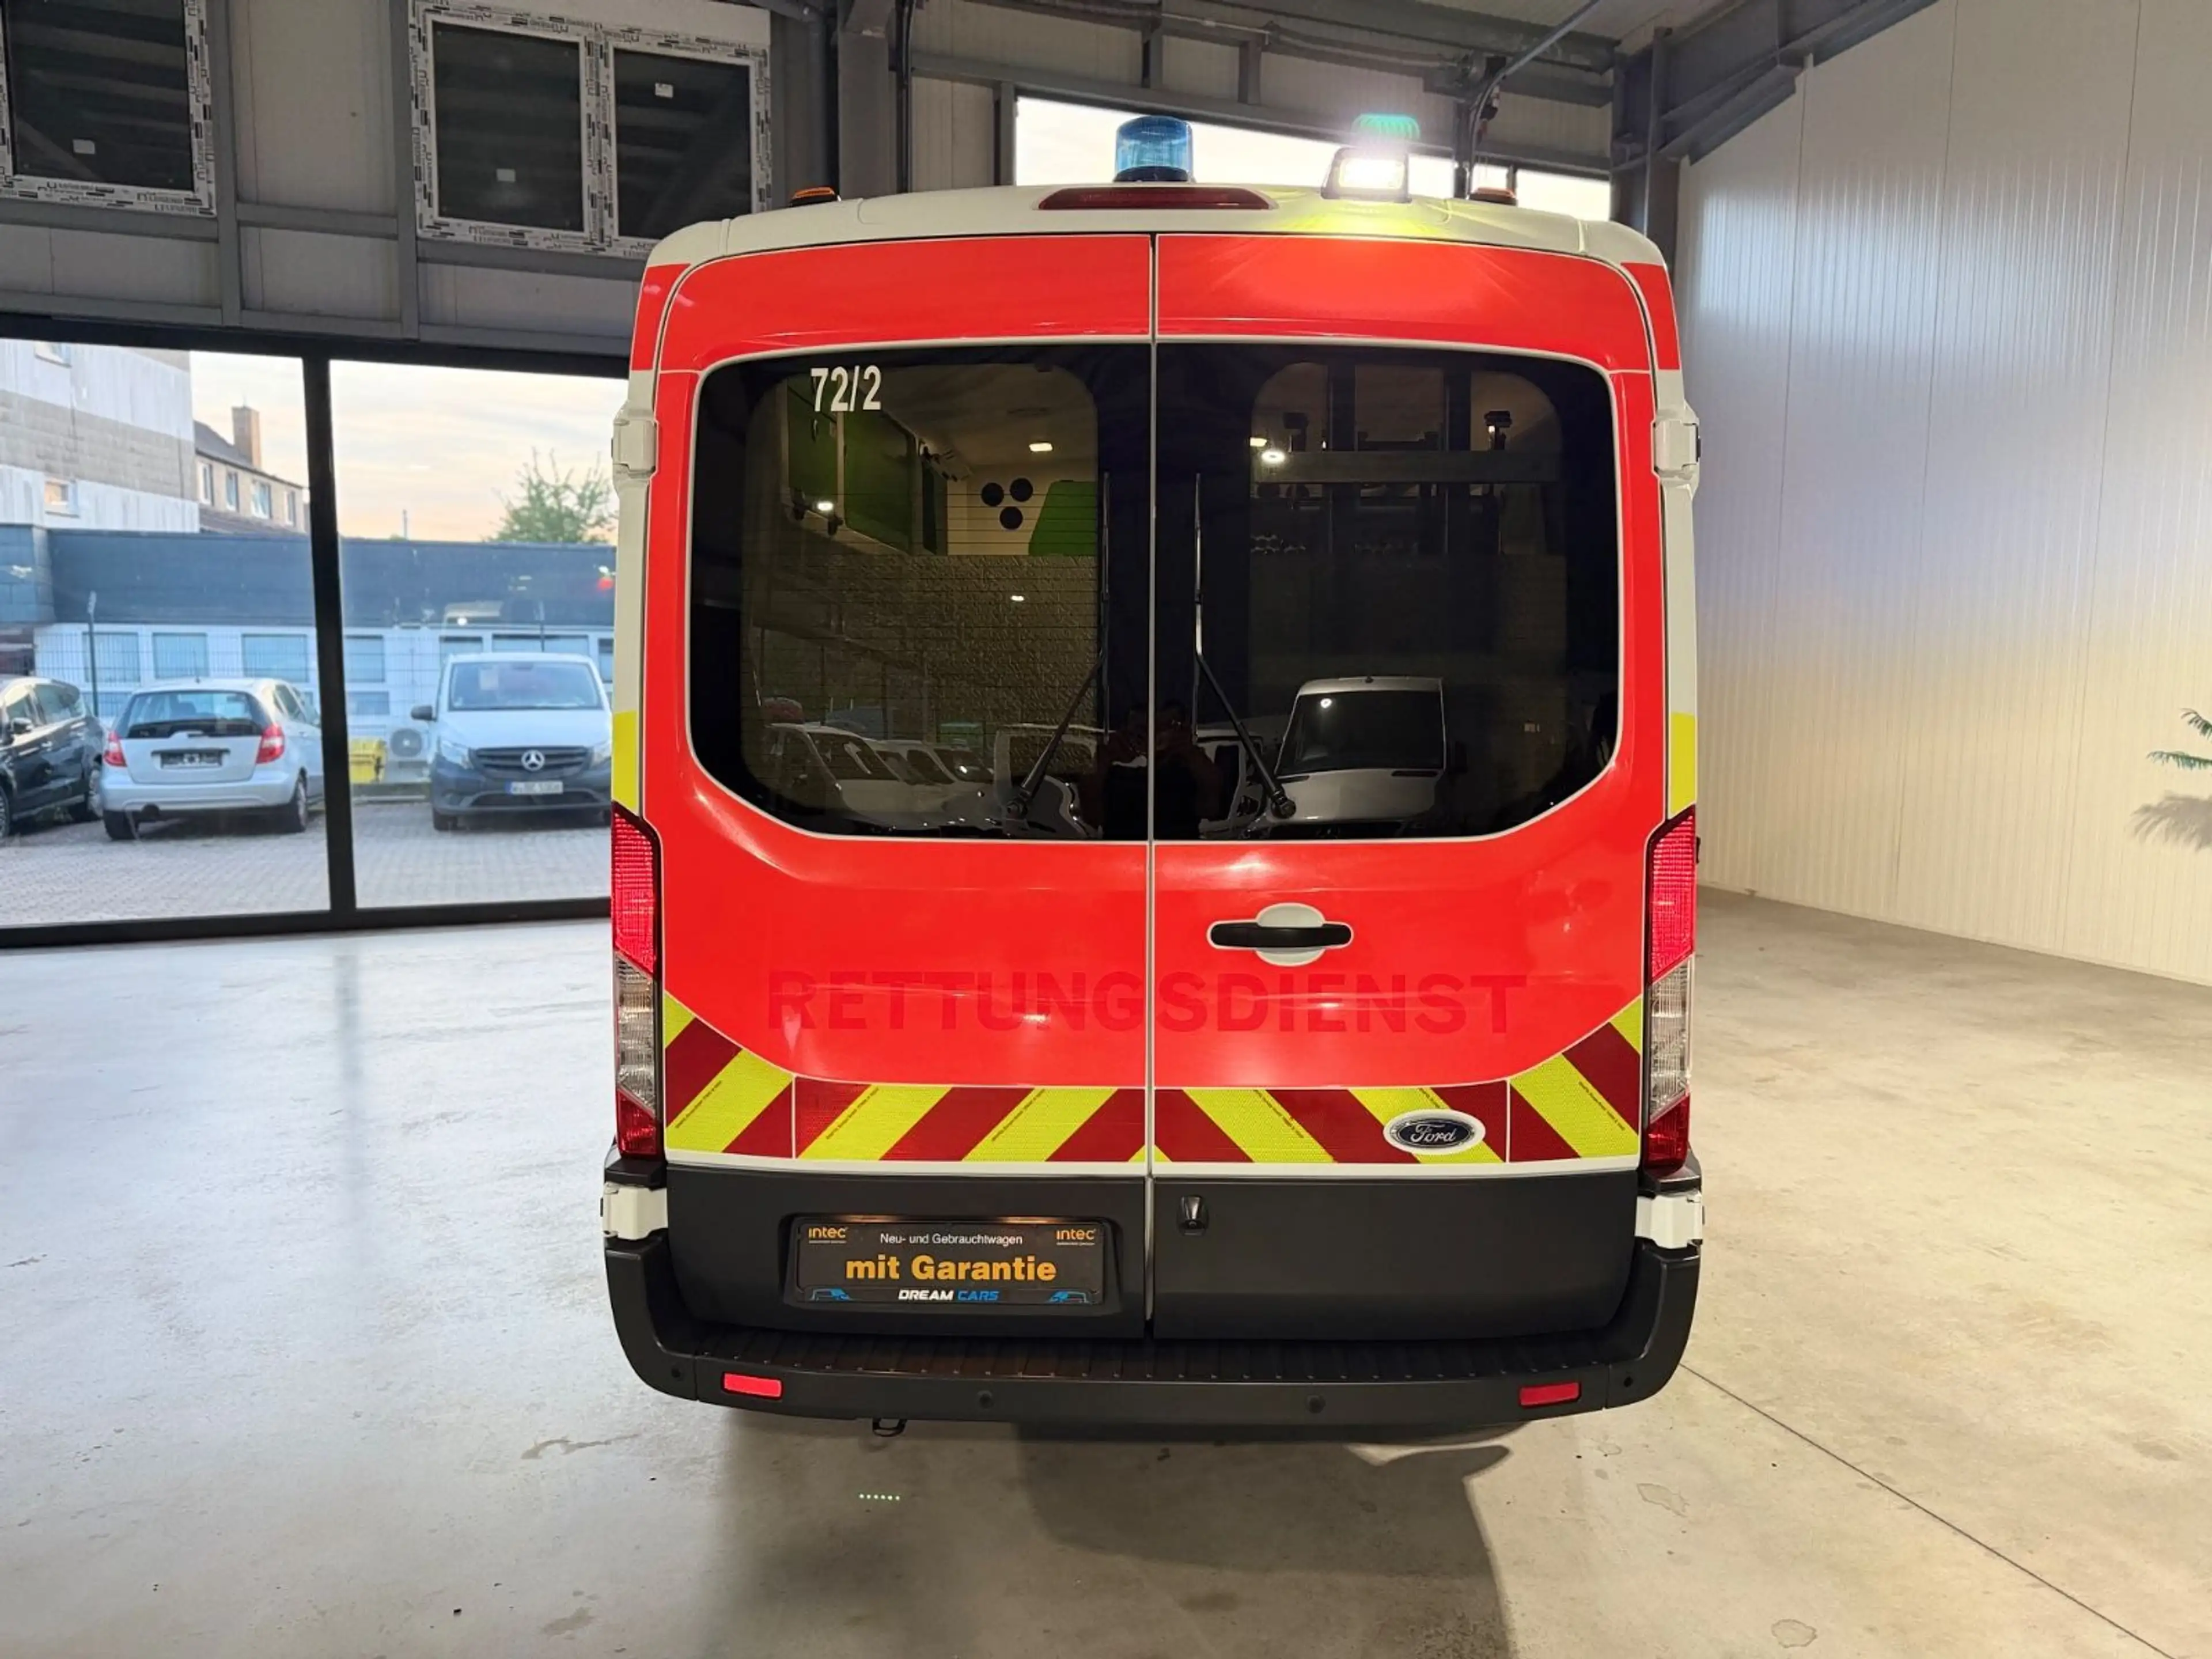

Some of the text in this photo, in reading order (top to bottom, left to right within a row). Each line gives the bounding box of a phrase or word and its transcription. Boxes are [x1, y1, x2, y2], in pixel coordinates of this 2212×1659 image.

[811, 365, 881, 411] 72/2
[769, 971, 1527, 1033] RETTUNGSDIENST
[1410, 1124, 1457, 1143] Ford
[809, 1226, 846, 1238] intec
[880, 1233, 1022, 1247] Neu- und Gebrauchtwagen
[1056, 1229, 1095, 1240] intec
[846, 1254, 1057, 1281] mit Garantie
[898, 1289, 999, 1301] DREAM CARS
